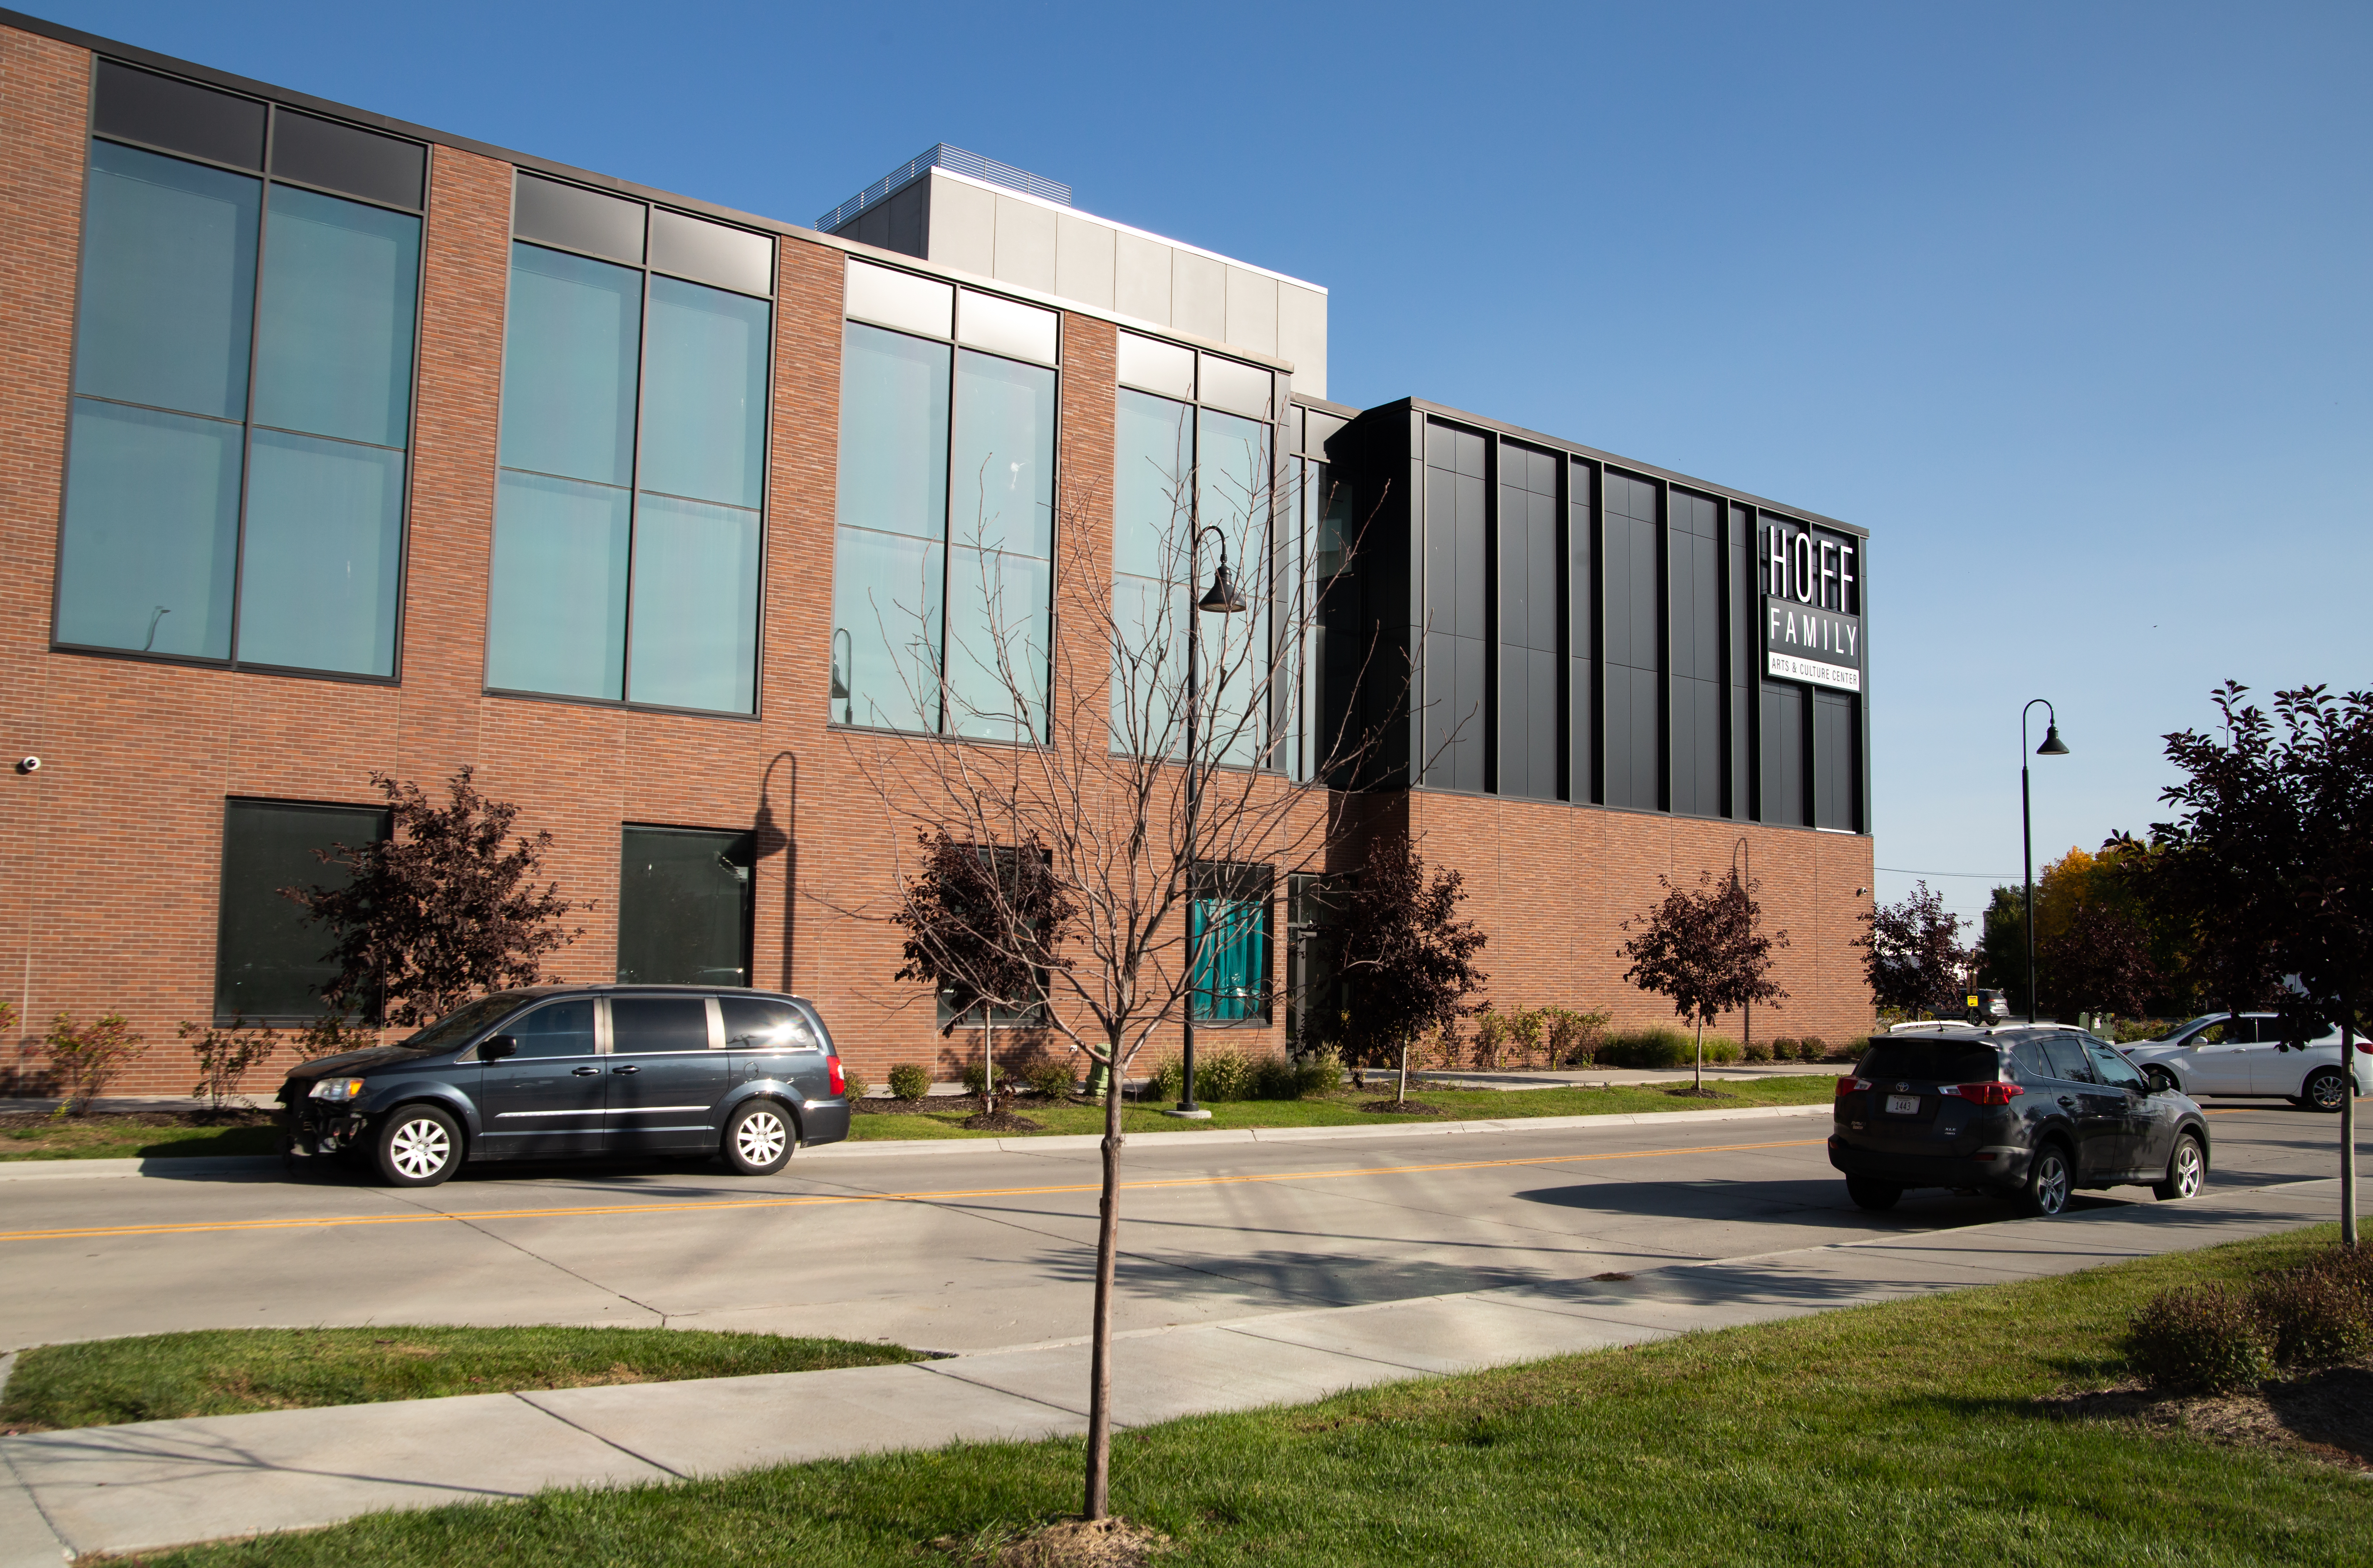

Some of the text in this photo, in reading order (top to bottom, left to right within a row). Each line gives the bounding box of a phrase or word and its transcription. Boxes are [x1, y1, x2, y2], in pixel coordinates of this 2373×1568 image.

[1770, 525, 1853, 612] HOFF
[1771, 607, 1856, 656] FAMILY
[1772, 658, 1857, 685] ARTS & CULTURE CENTER
[1895, 1101, 1911, 1110] 1443
